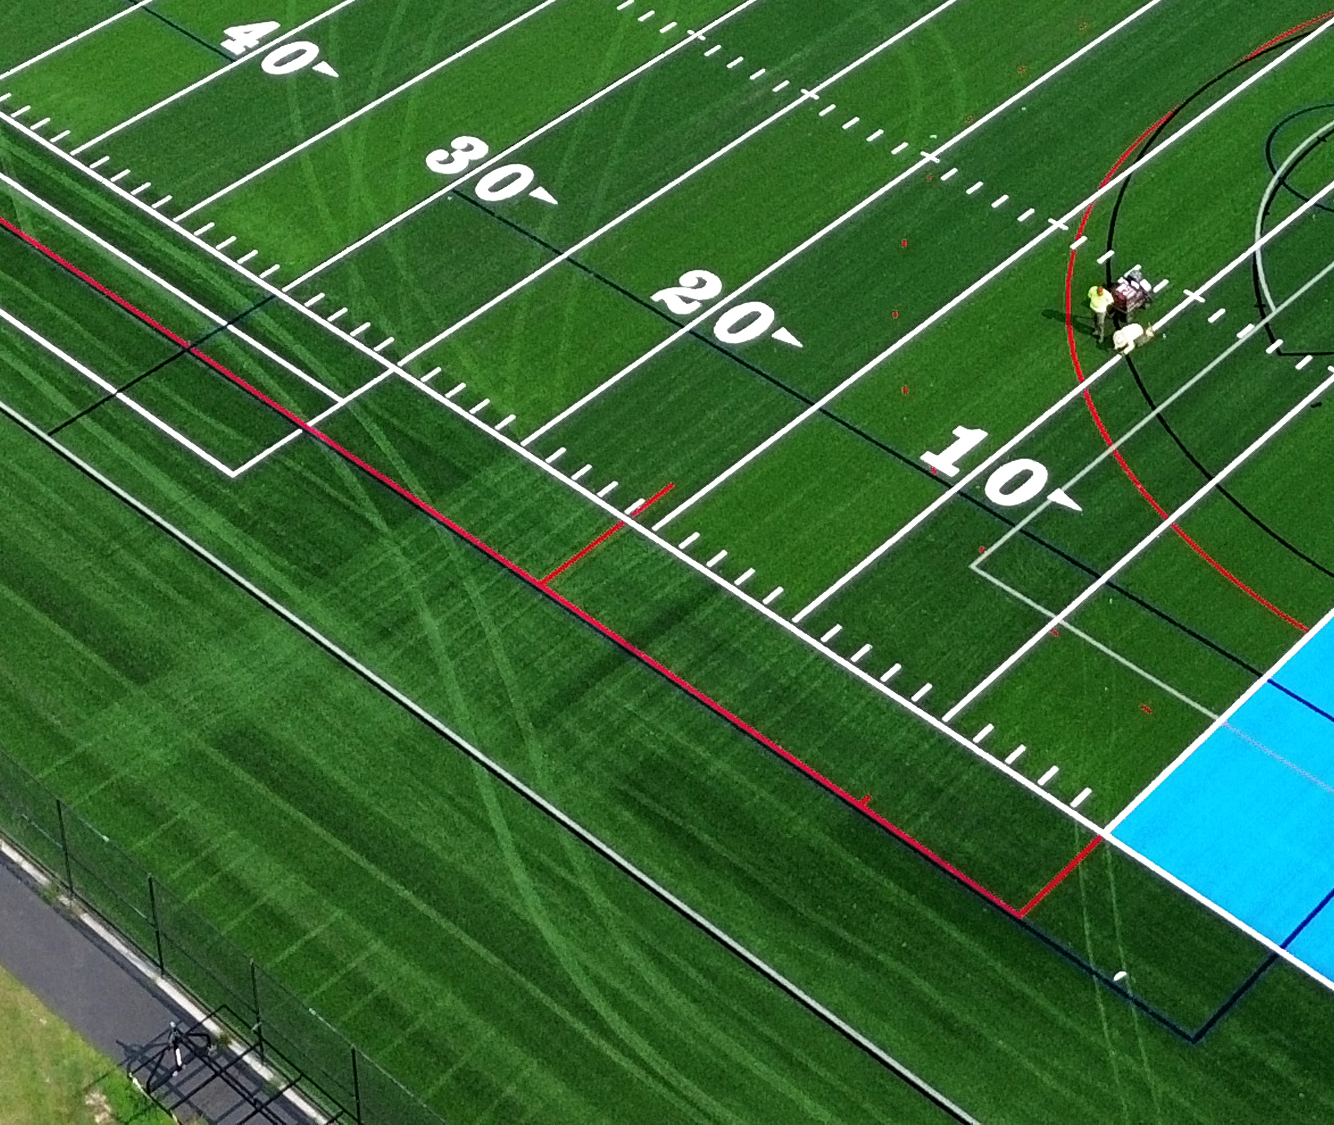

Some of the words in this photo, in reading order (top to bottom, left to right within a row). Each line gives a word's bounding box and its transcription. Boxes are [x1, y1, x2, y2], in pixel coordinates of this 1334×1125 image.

[220, 20, 319, 76] 40
[425, 135, 535, 202] 30
[651, 270, 776, 345] 20
[920, 426, 1049, 506] 10
